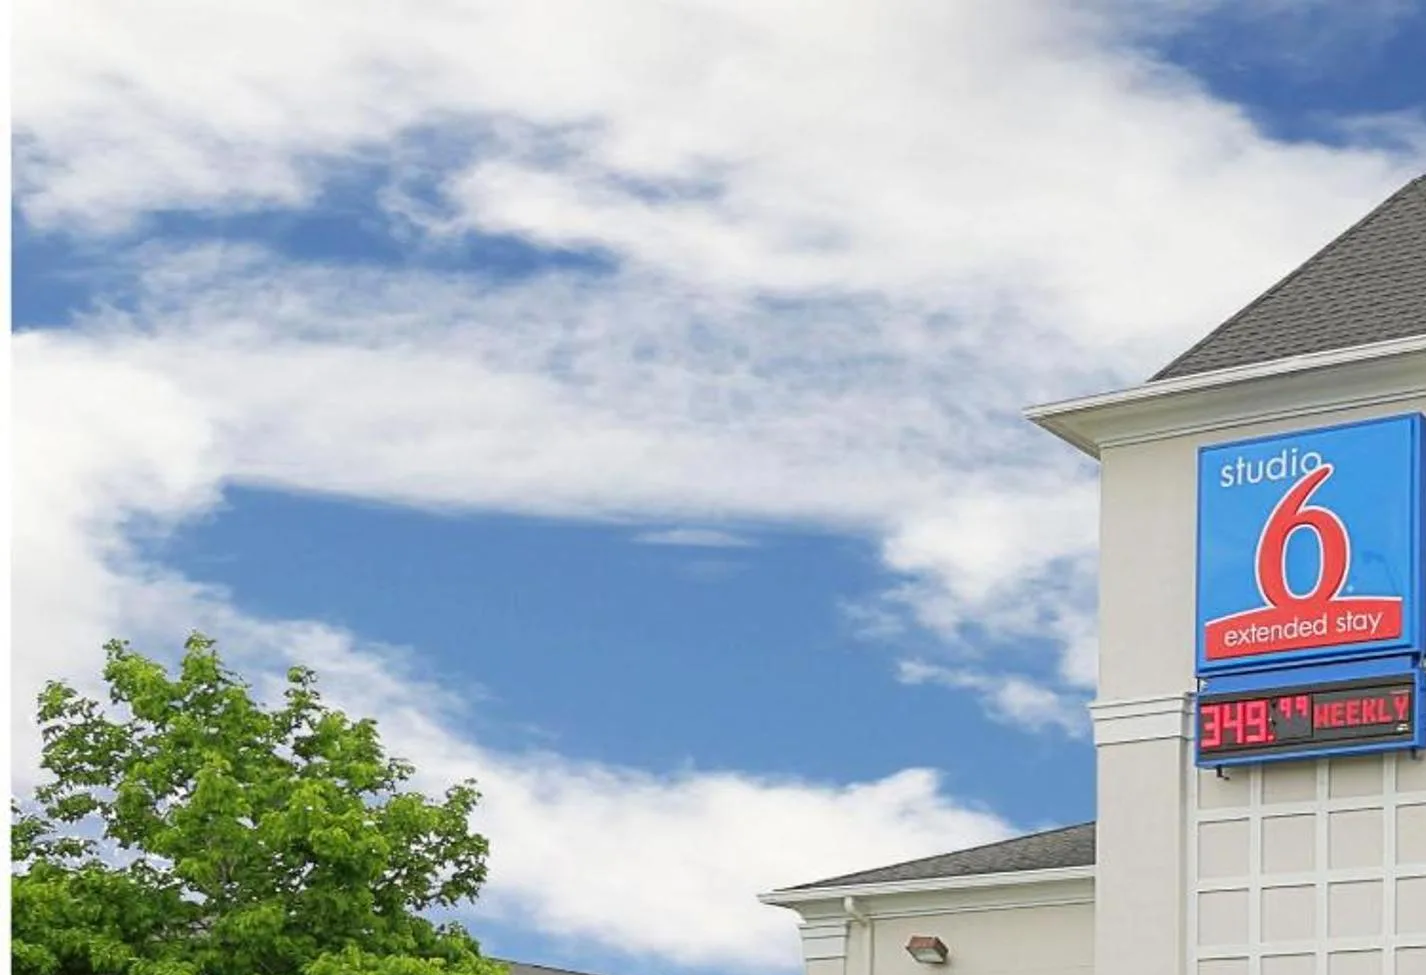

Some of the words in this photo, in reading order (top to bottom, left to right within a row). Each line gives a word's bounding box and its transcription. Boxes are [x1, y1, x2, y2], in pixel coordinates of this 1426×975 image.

[1220, 449, 1322, 488] studio
[1255, 463, 1350, 608] 6
[1223, 611, 1328, 648] extended
[1336, 609, 1384, 634] stay
[1314, 693, 1410, 728] WEEKLY
